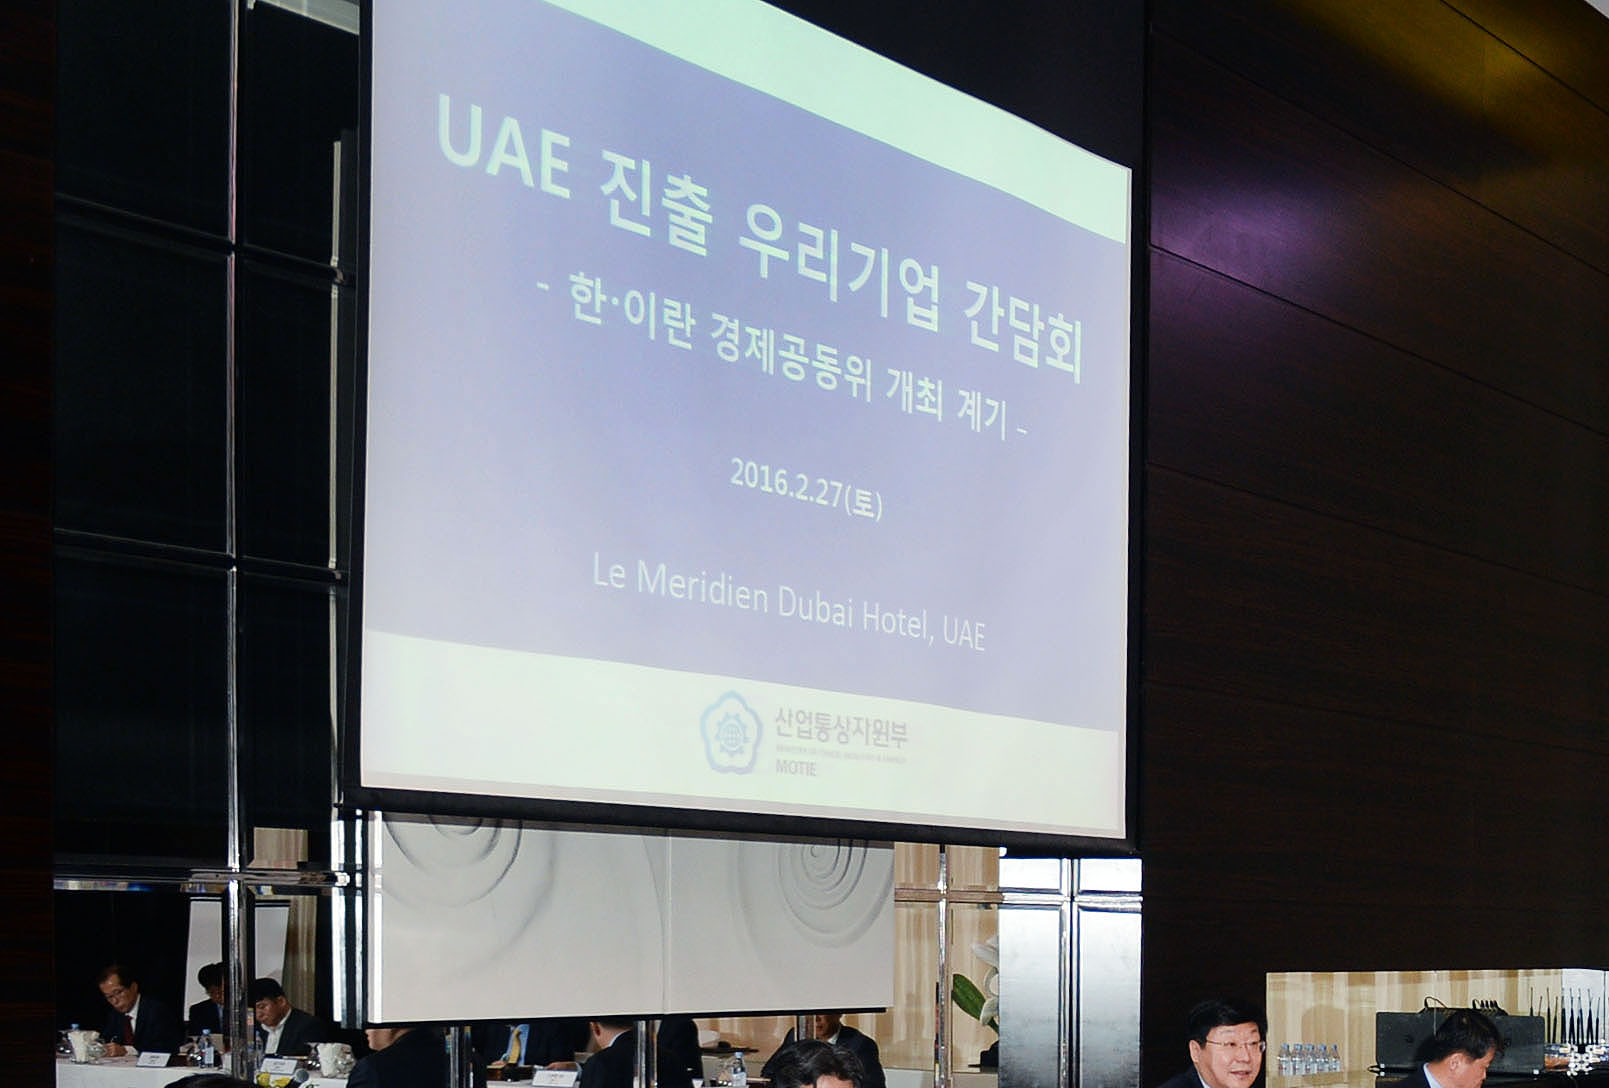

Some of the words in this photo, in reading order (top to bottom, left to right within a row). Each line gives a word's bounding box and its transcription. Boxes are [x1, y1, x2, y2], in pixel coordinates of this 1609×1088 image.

[438, 93, 571, 200] UAE
[599, 149, 714, 257] 진출
[738, 203, 940, 333] 우리기업
[963, 279, 1082, 385] 간담회
[710, 311, 873, 403] 경제공동위
[885, 368, 943, 423] 개최
[957, 389, 1007, 441] 계기
[730, 457, 883, 523] 2016.2.27(토)
[594, 551, 626, 589] Le
[638, 559, 768, 613] Meridien
[779, 585, 854, 628] Dubai
[863, 601, 935, 646] Hotel,
[943, 615, 986, 652] UAE
[775, 707, 909, 749] 산업통상자원부
